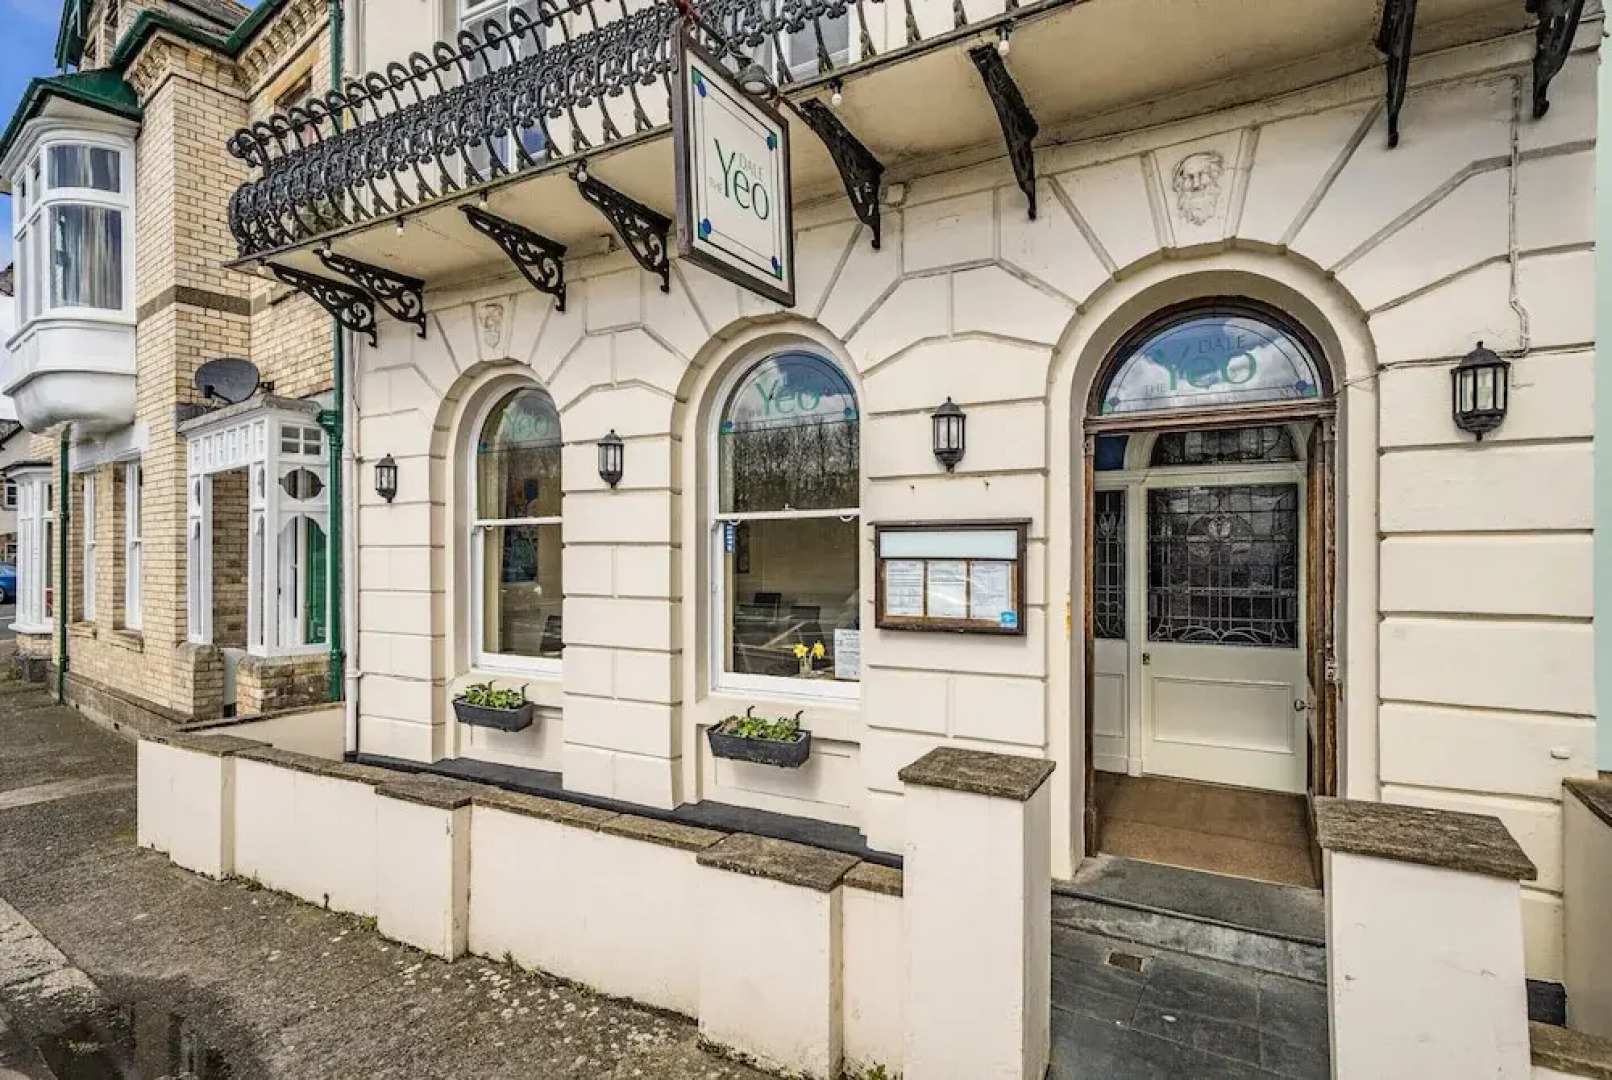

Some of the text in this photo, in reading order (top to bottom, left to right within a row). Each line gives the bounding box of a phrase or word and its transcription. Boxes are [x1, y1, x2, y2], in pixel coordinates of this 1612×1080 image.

[713, 137, 770, 220] Yeo
[1198, 334, 1246, 354] DALE
[1153, 345, 1257, 390] Yeo
[755, 379, 821, 416] Yeo
[502, 409, 551, 439] Yeo
